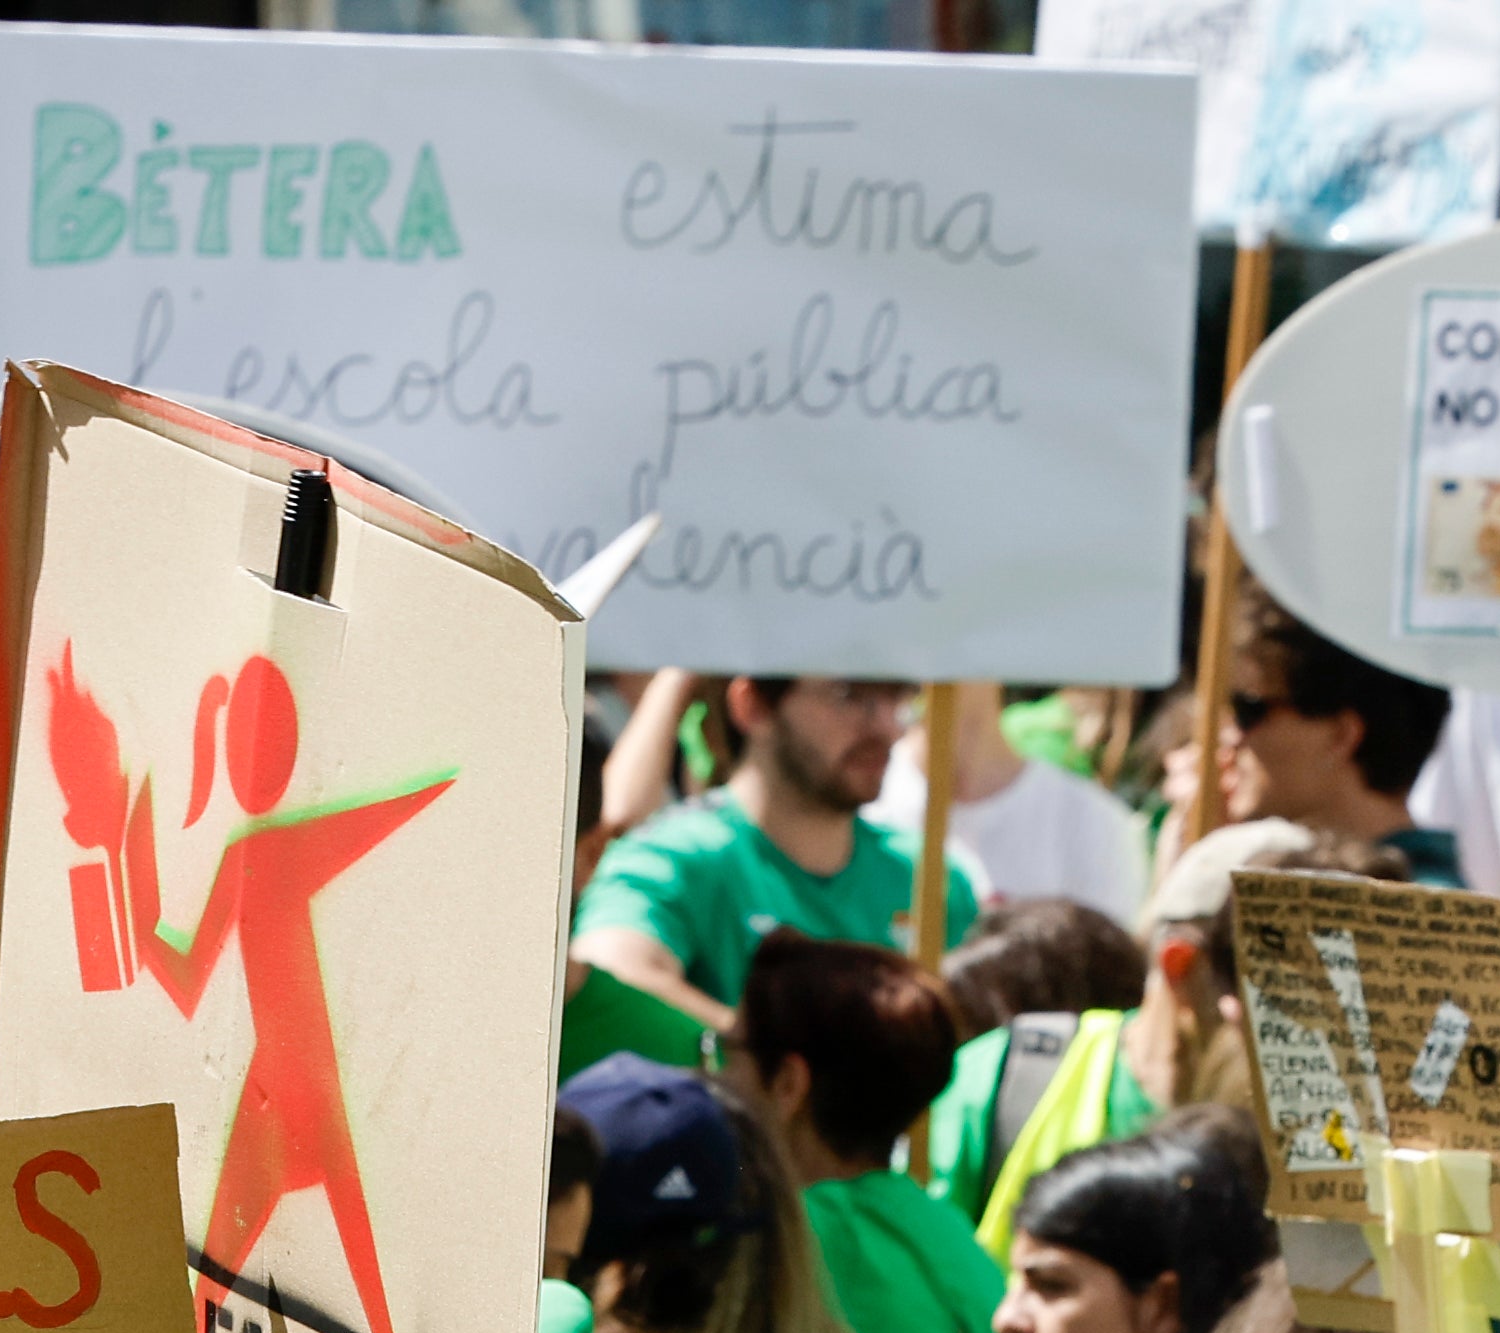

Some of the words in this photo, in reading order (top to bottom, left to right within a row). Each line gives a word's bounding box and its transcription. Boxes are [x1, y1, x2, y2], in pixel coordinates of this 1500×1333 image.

[618, 105, 1040, 268] estima
[654, 291, 1023, 480] pública
[1432, 389, 1497, 428] NO
